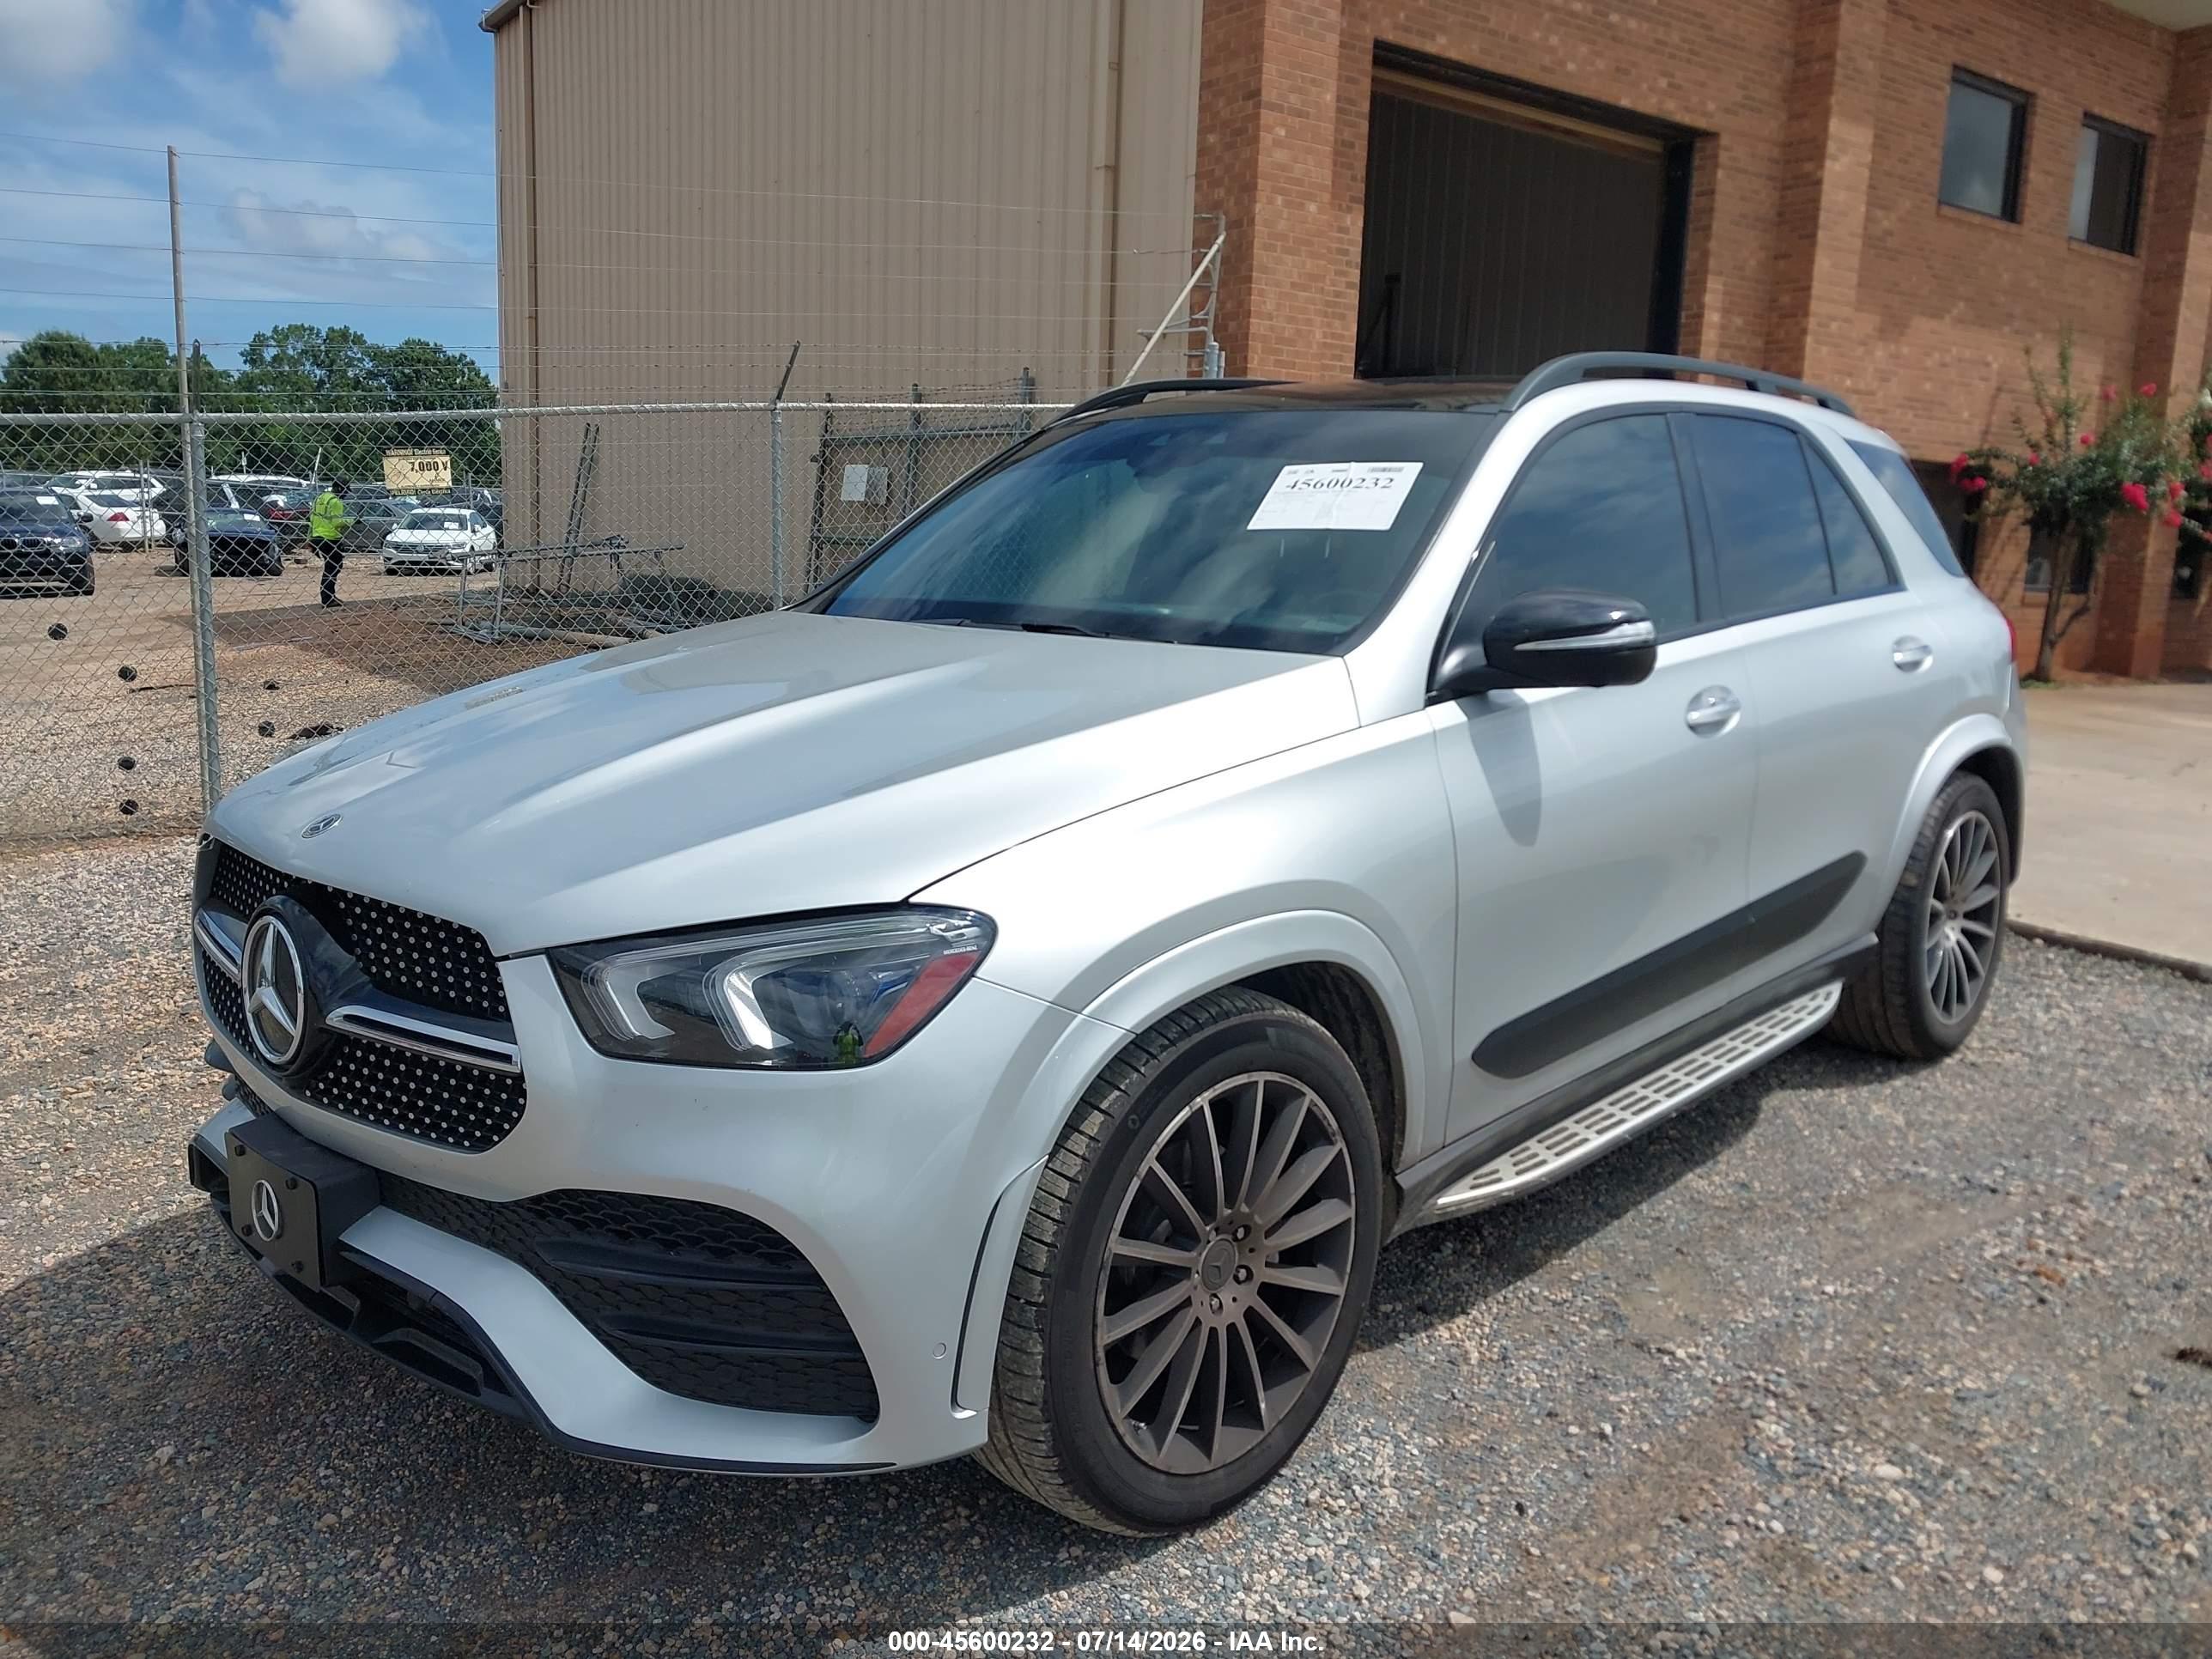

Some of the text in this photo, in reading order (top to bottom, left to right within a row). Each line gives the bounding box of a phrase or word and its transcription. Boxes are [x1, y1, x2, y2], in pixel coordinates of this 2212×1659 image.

[409, 460, 448, 473] 7,000 V
[1285, 477, 1395, 490] 45600232
